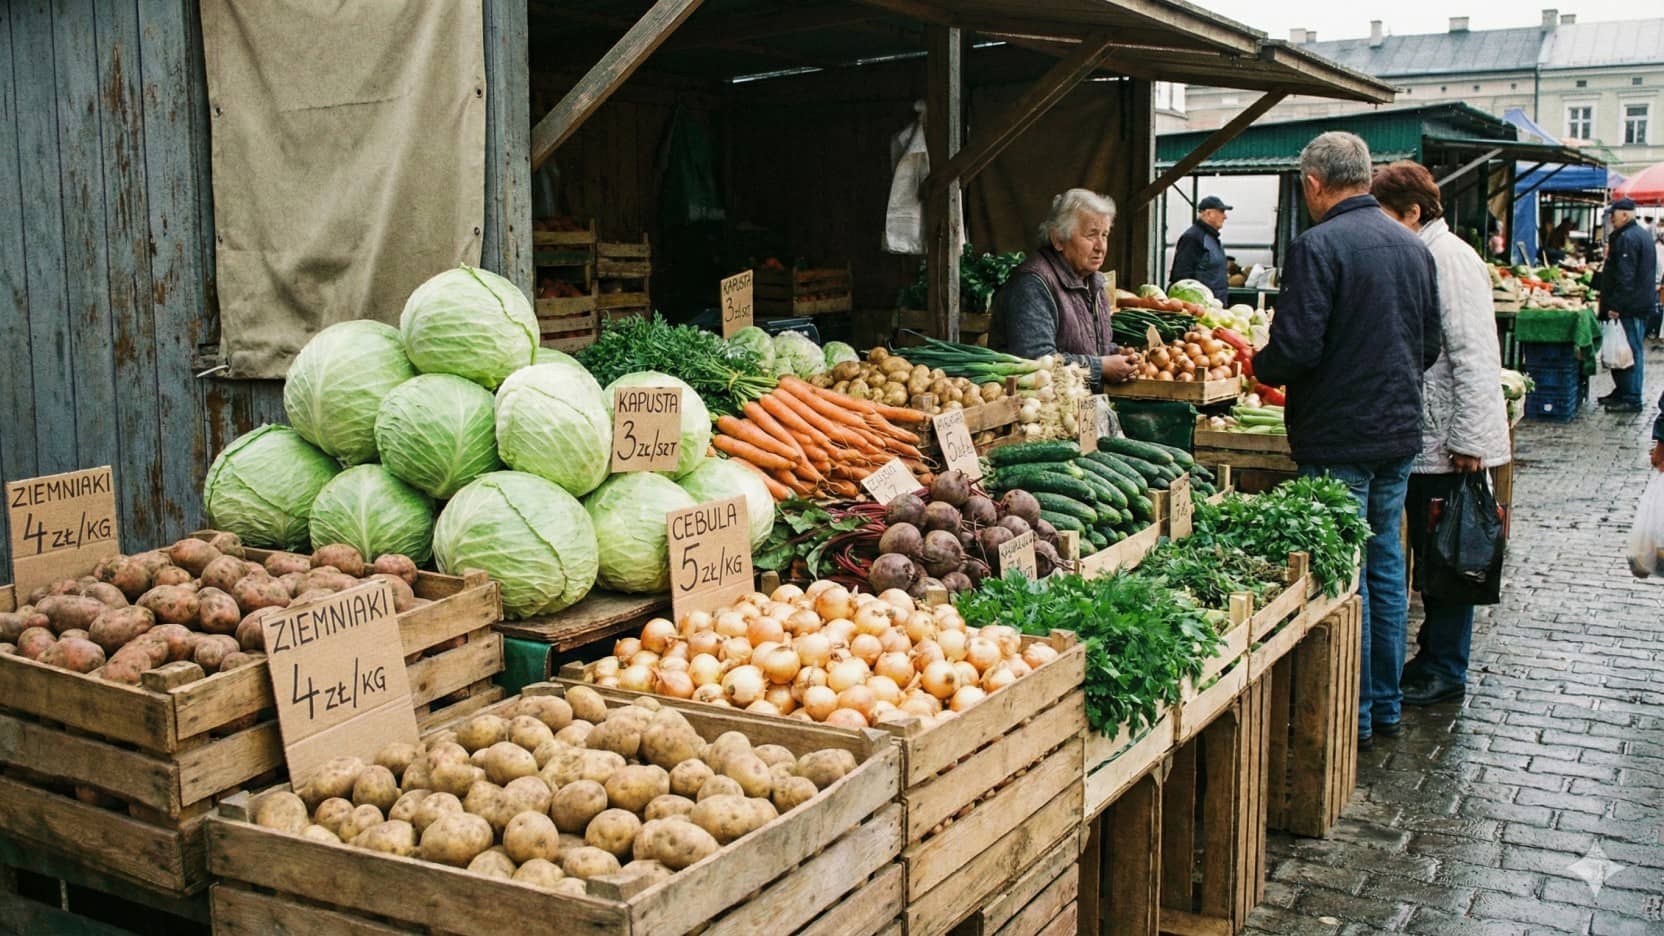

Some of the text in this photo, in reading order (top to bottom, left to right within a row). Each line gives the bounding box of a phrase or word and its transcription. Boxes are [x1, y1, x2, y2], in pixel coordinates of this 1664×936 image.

[725, 297, 735, 322] 3
[618, 391, 678, 414] KAPUSTA
[617, 420, 637, 461] 3
[12, 471, 111, 508] ZIEMNIAKI
[23, 511, 112, 555] 4 ZŁ/KG
[672, 503, 737, 541] CEBULA
[680, 542, 743, 592] 5 ZŁ/KG
[269, 588, 389, 654] ZIEMNIAKI
[292, 657, 387, 720] 4 ZŁ/KG
